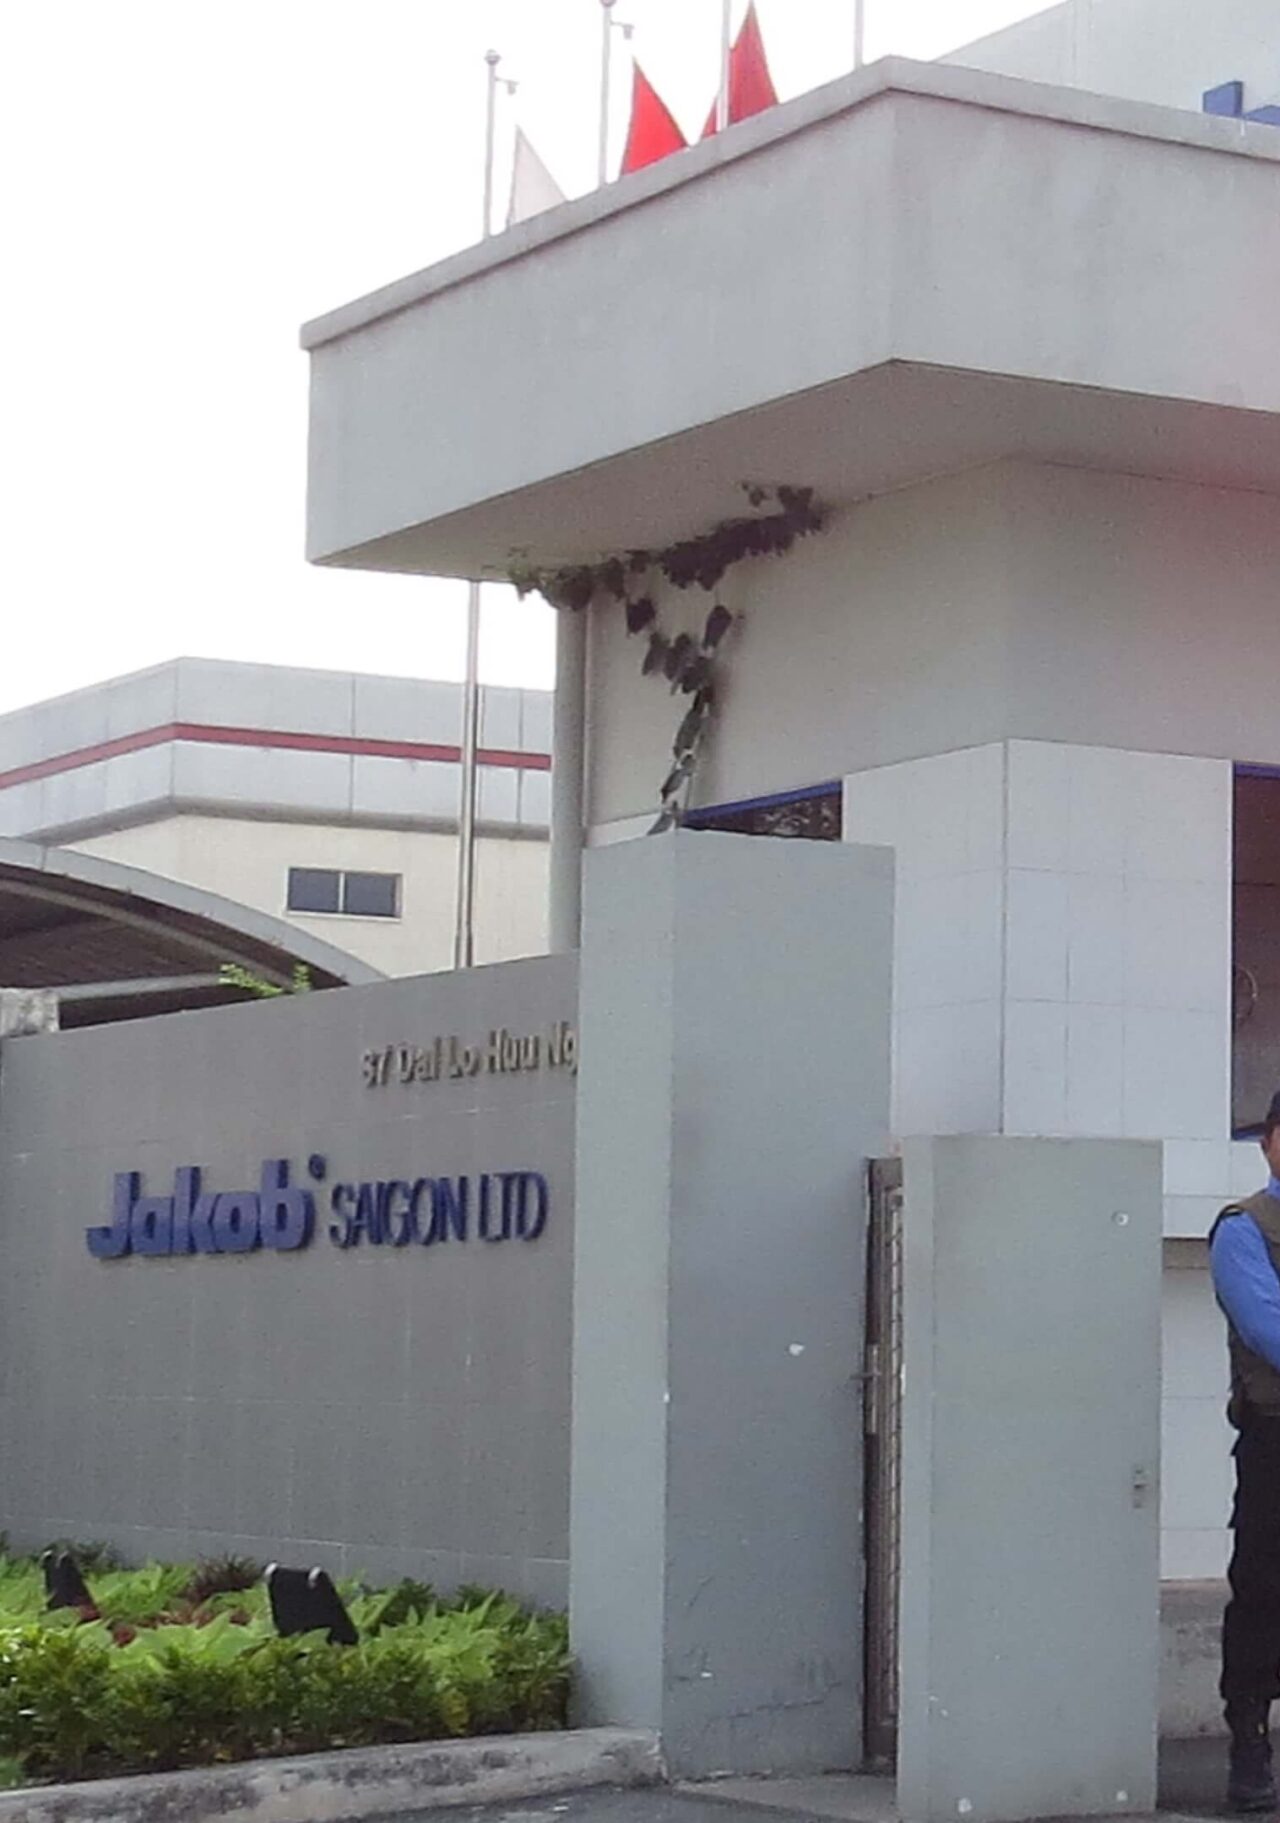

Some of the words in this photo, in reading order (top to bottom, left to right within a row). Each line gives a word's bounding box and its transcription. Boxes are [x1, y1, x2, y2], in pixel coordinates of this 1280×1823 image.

[446, 1035, 481, 1079] Lo
[486, 1028, 540, 1075] Huu
[86, 1157, 317, 1260] Jakob
[330, 1175, 467, 1249] SAIGON
[478, 1171, 549, 1242] LTD
